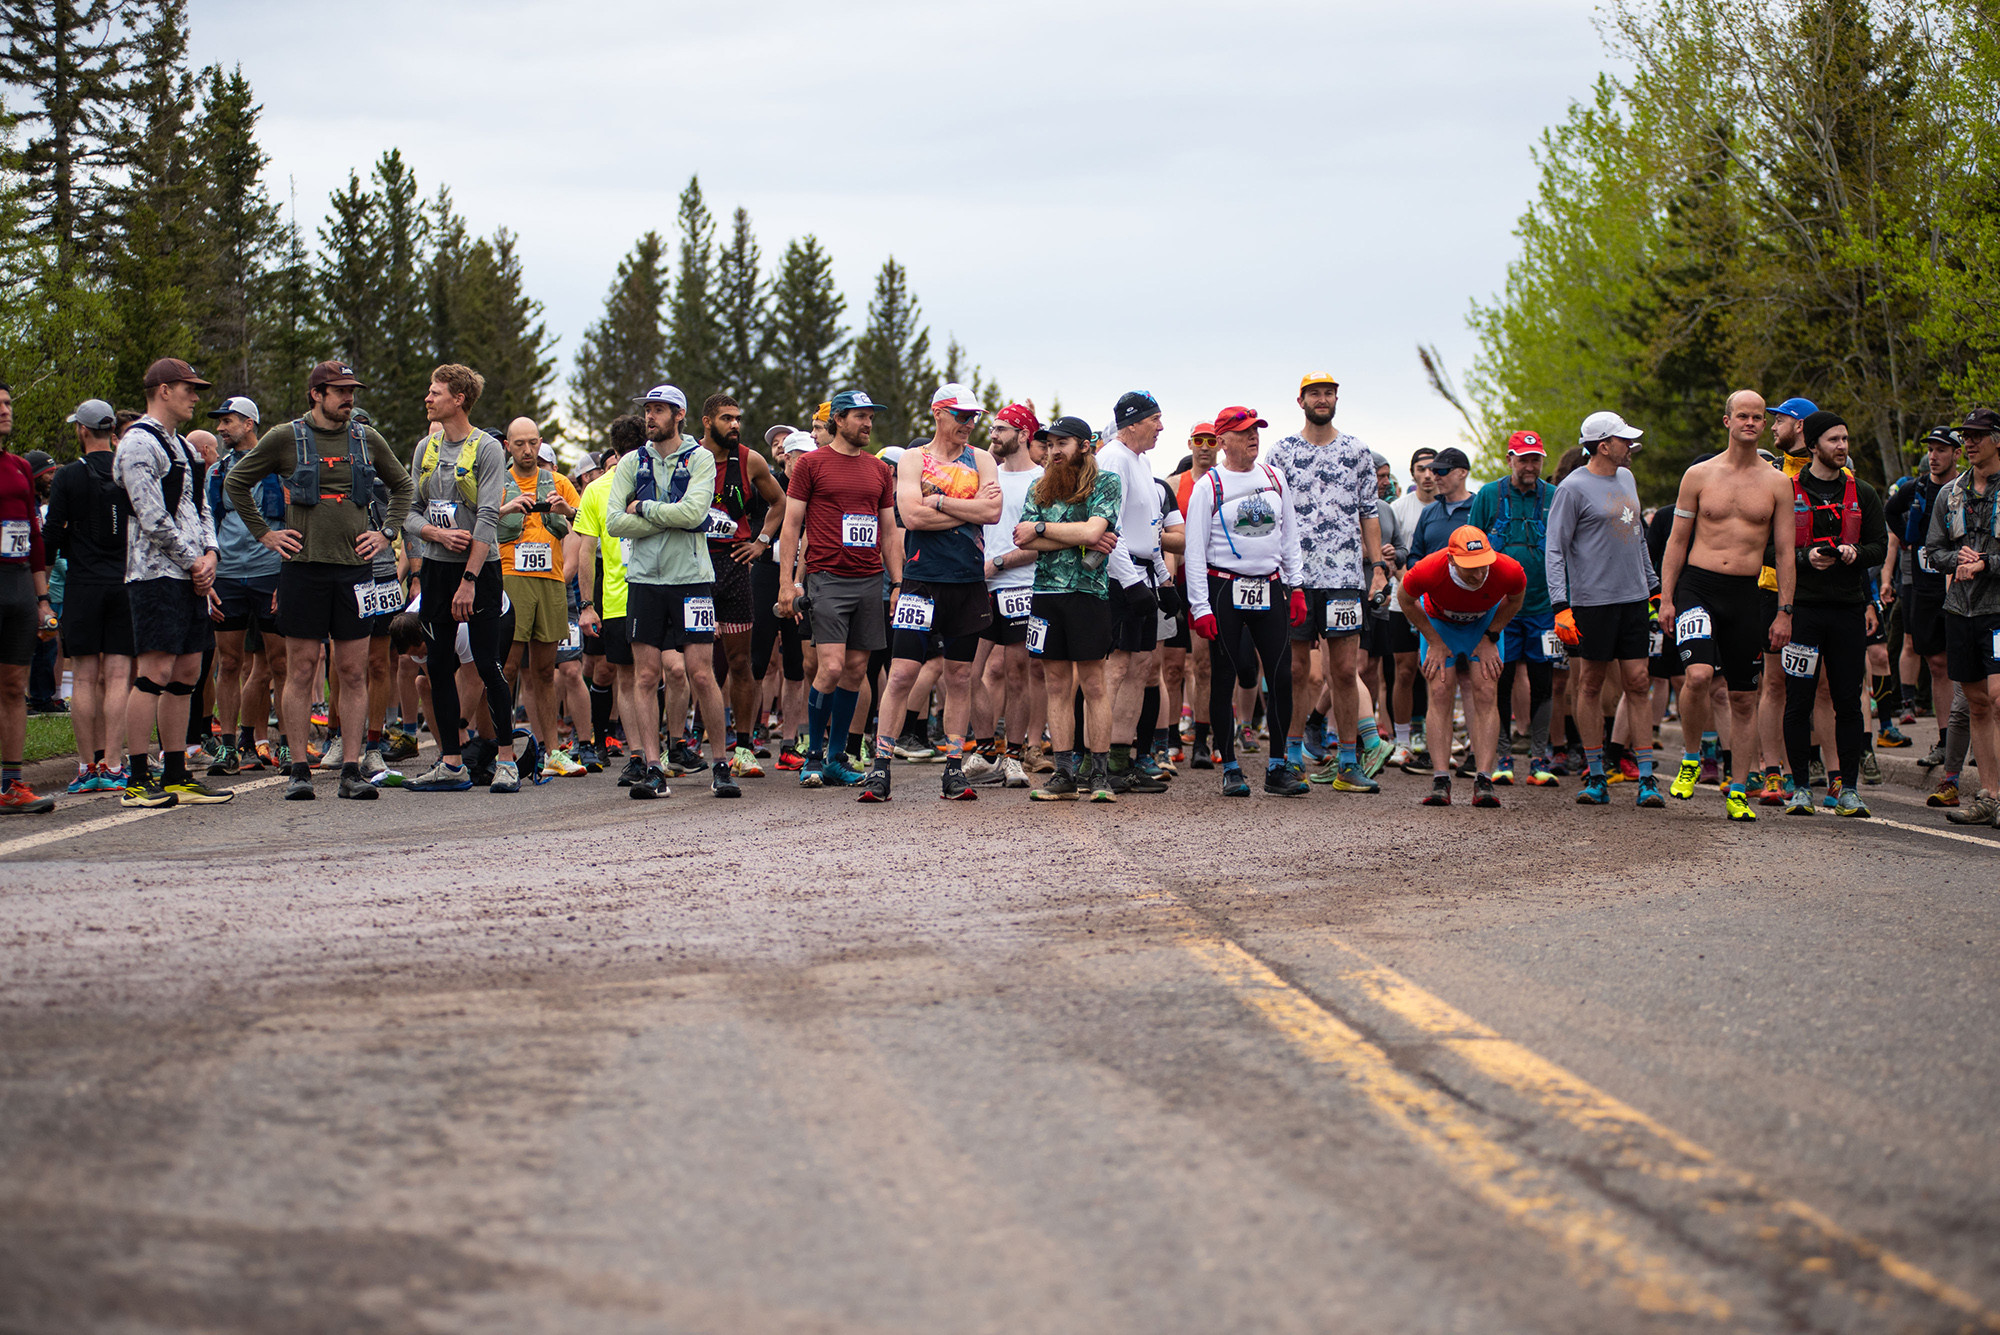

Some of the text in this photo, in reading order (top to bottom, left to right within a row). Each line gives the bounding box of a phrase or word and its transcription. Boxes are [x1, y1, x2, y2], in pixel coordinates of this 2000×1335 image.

[431, 513, 451, 529] 840
[849, 527, 873, 542] 602
[522, 554, 546, 568] 795
[378, 591, 402, 609] 839
[1005, 596, 1032, 613] 663
[1240, 589, 1263, 605] 764
[897, 608, 925, 625] 585
[1680, 618, 1704, 638] 807
[1785, 653, 1809, 673] 579
